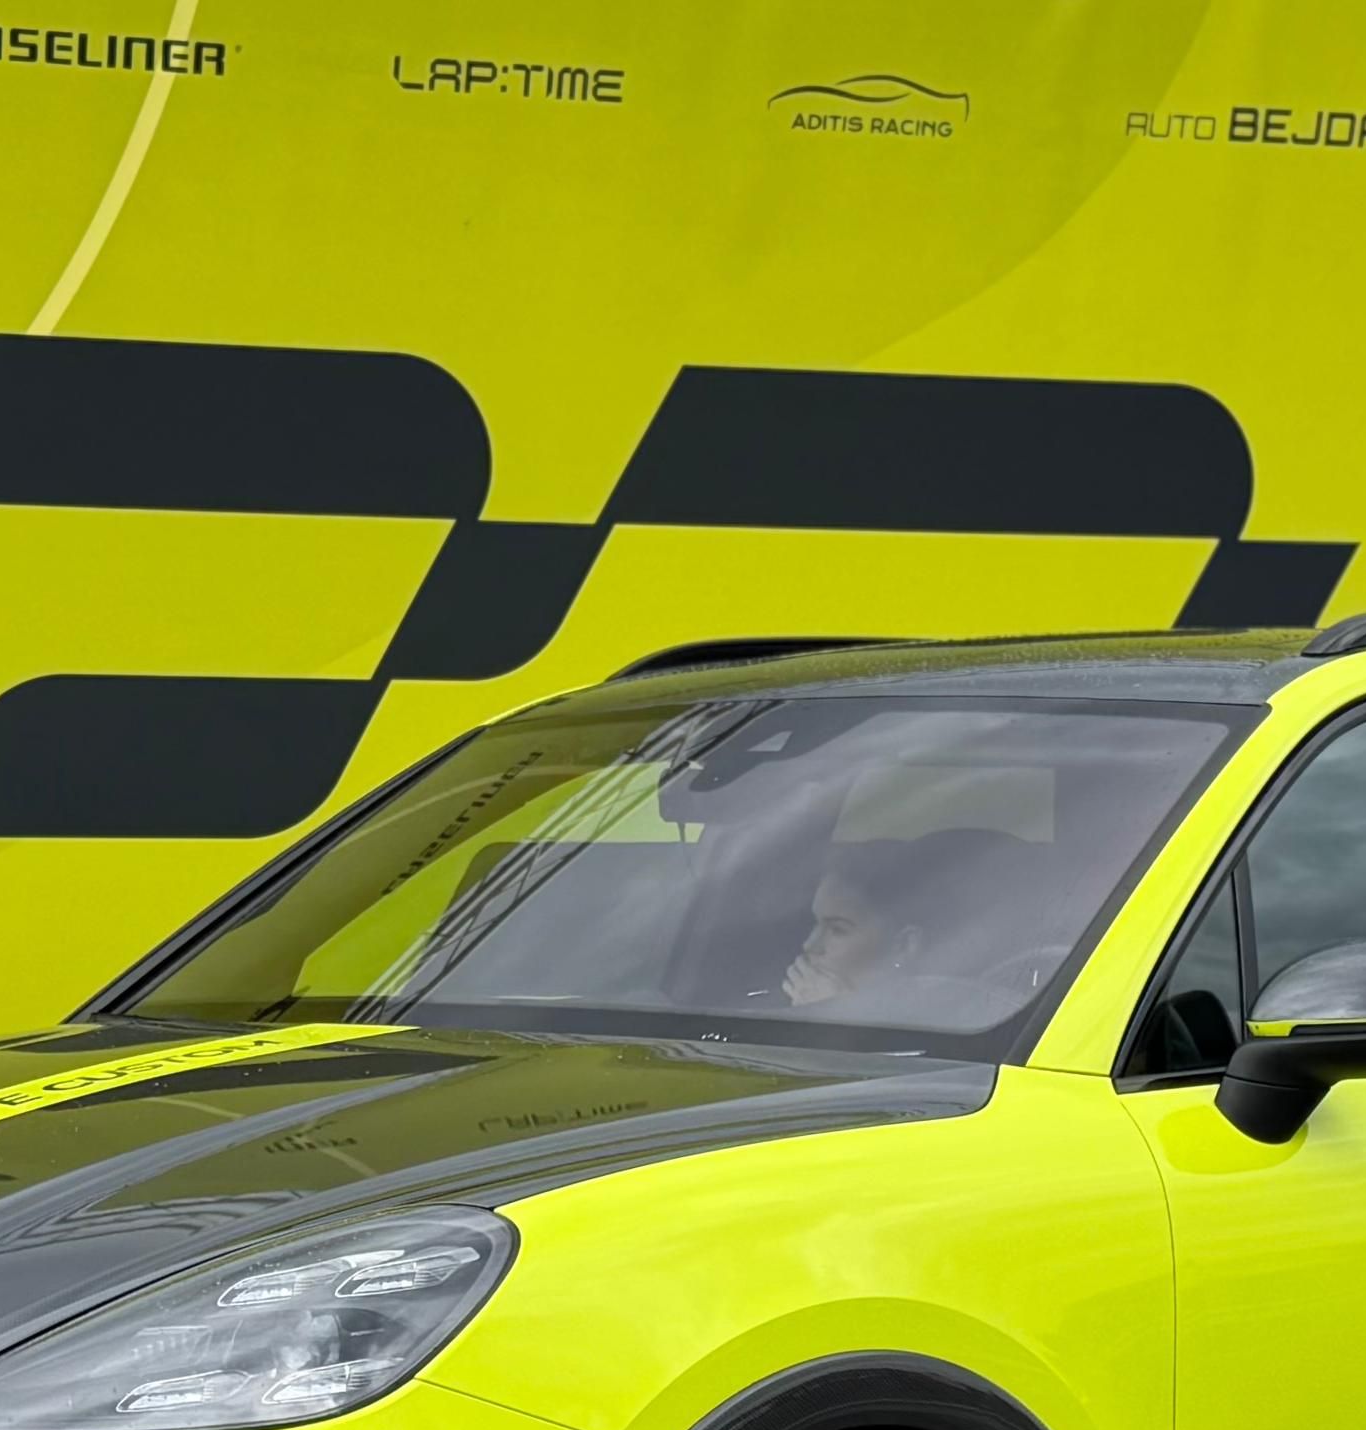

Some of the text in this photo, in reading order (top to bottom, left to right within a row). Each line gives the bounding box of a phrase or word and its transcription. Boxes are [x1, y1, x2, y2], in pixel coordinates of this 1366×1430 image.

[393, 55, 625, 103] LAP:TIME
[791, 113, 953, 138] ADITIS RACING
[1126, 112, 1217, 141] AUTO
[42, 1038, 285, 1093] CUSTOM
